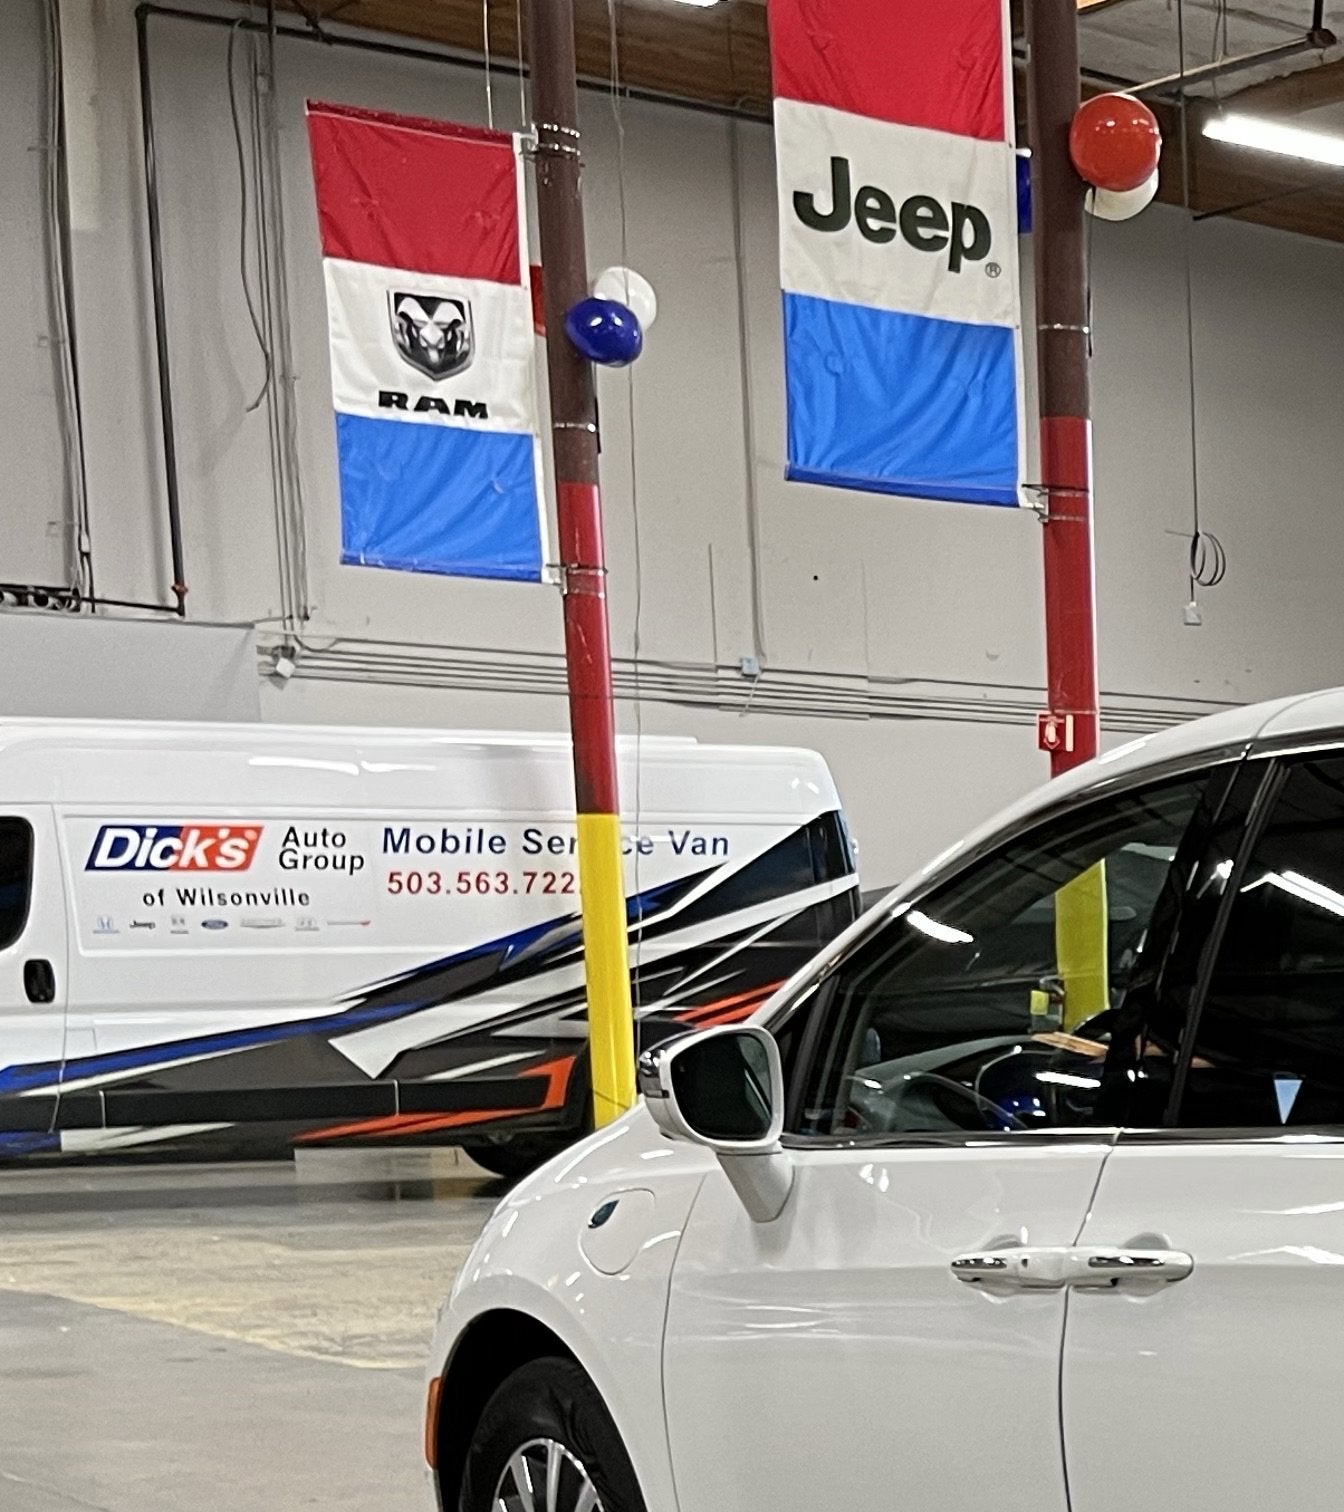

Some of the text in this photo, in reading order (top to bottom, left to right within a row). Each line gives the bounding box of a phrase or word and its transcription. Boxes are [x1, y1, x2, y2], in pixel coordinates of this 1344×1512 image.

[379, 391, 488, 419] RAM
[282, 826, 346, 848] Auto
[382, 828, 730, 856] Mobile Serce Van
[278, 849, 365, 876] Group
[387, 871, 576, 895] 503.563.722
[143, 888, 310, 906] of Wilsonville
